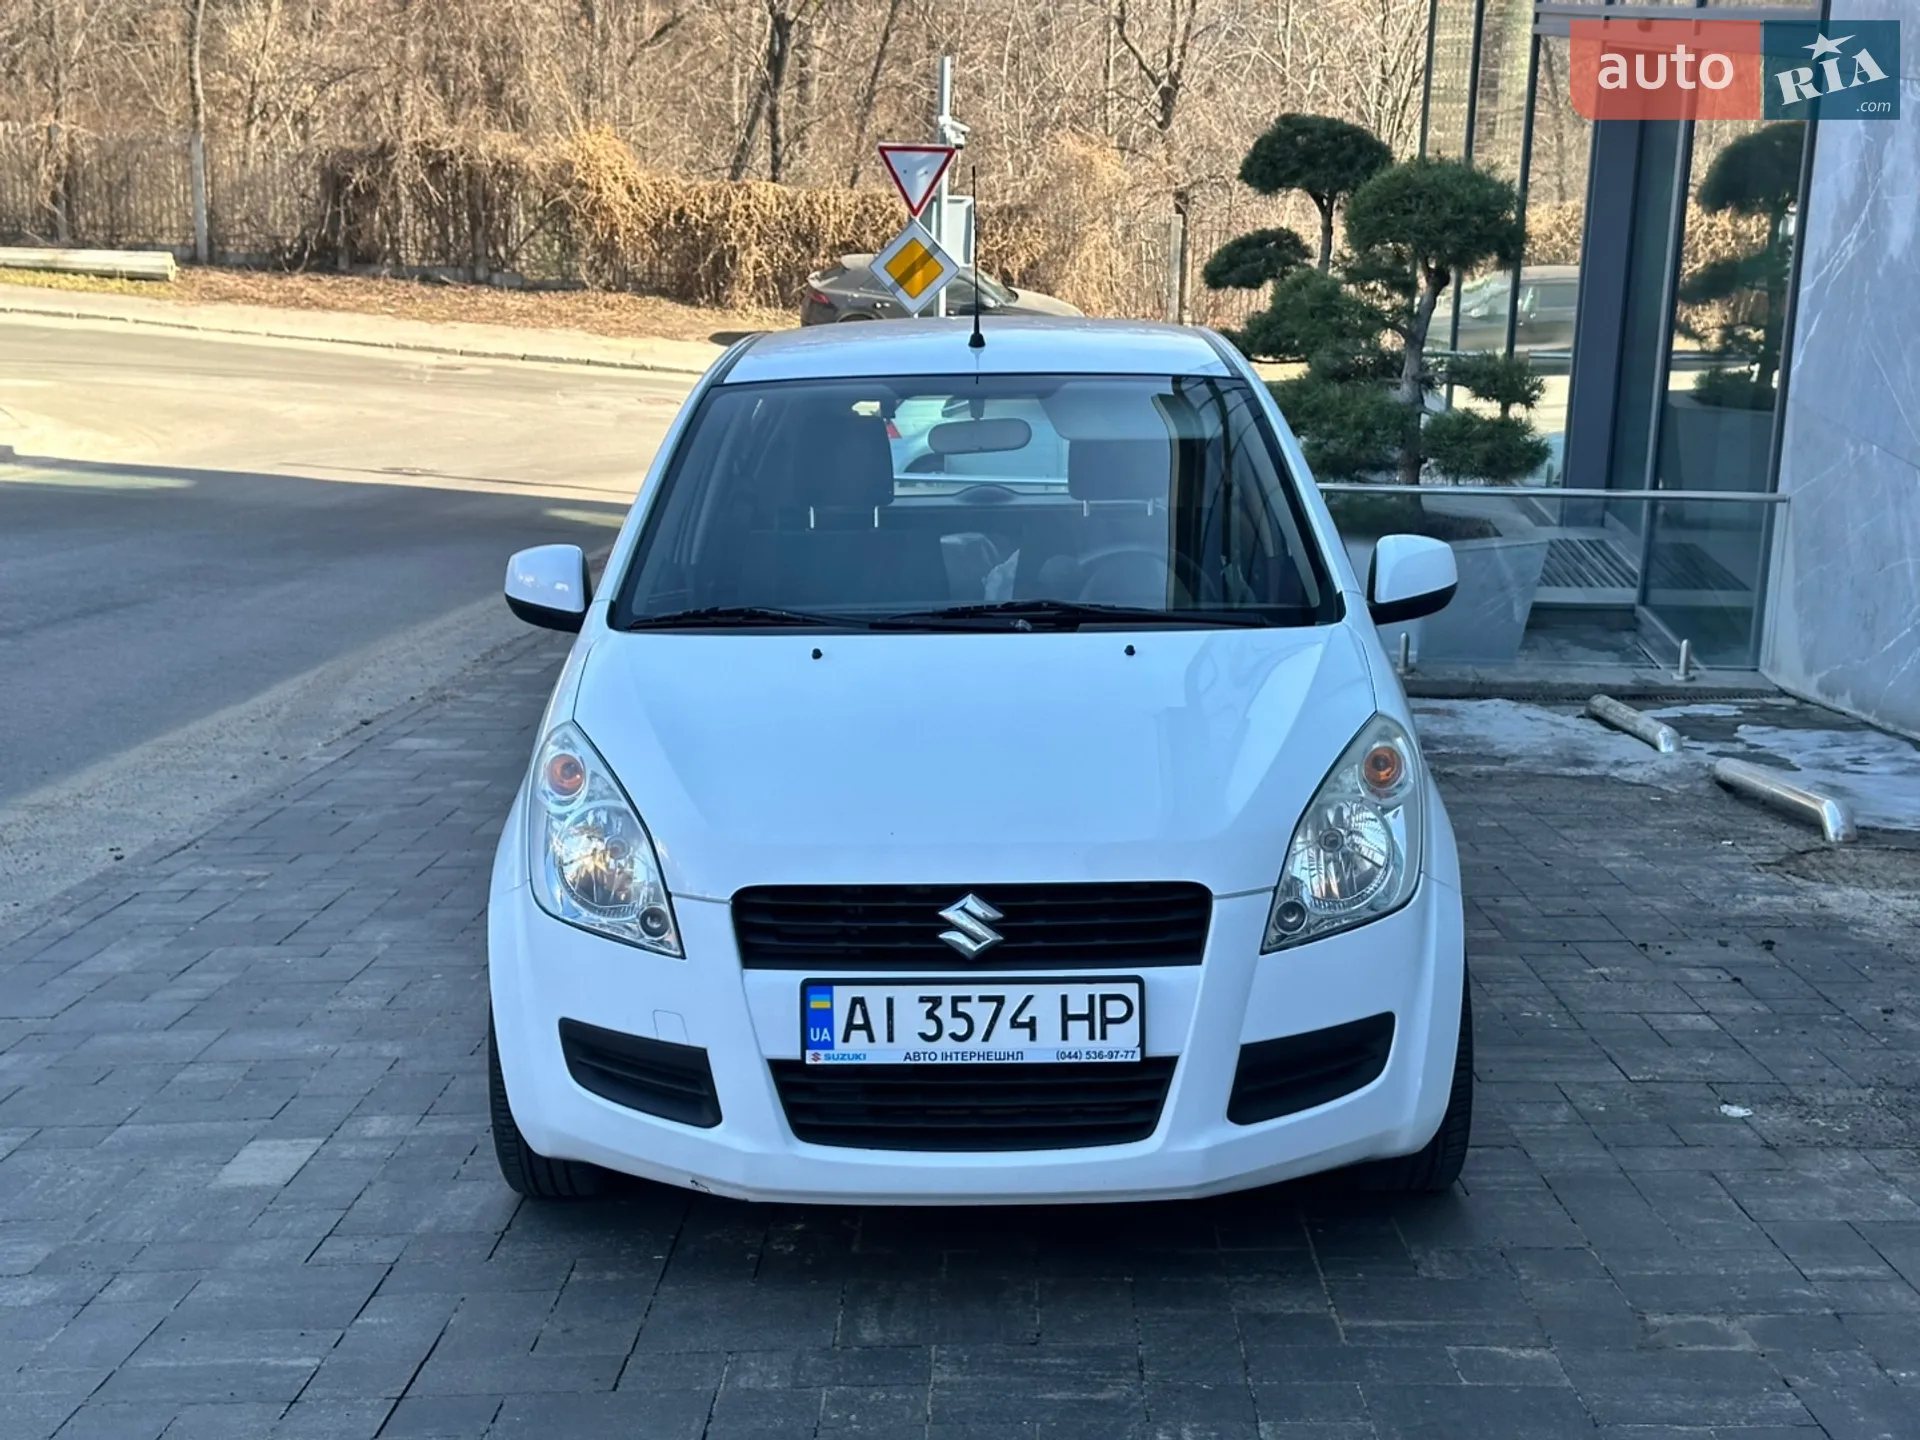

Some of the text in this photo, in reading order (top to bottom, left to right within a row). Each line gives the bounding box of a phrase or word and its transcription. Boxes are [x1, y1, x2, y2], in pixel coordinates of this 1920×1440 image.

[842, 993, 1134, 1043] AI 3574 HP
[810, 1028, 831, 1042] UA
[824, 1053, 867, 1061] SUZUKI
[903, 1051, 938, 1062] АВТО
[1056, 1050, 1136, 1061] (044) 536-97-77
